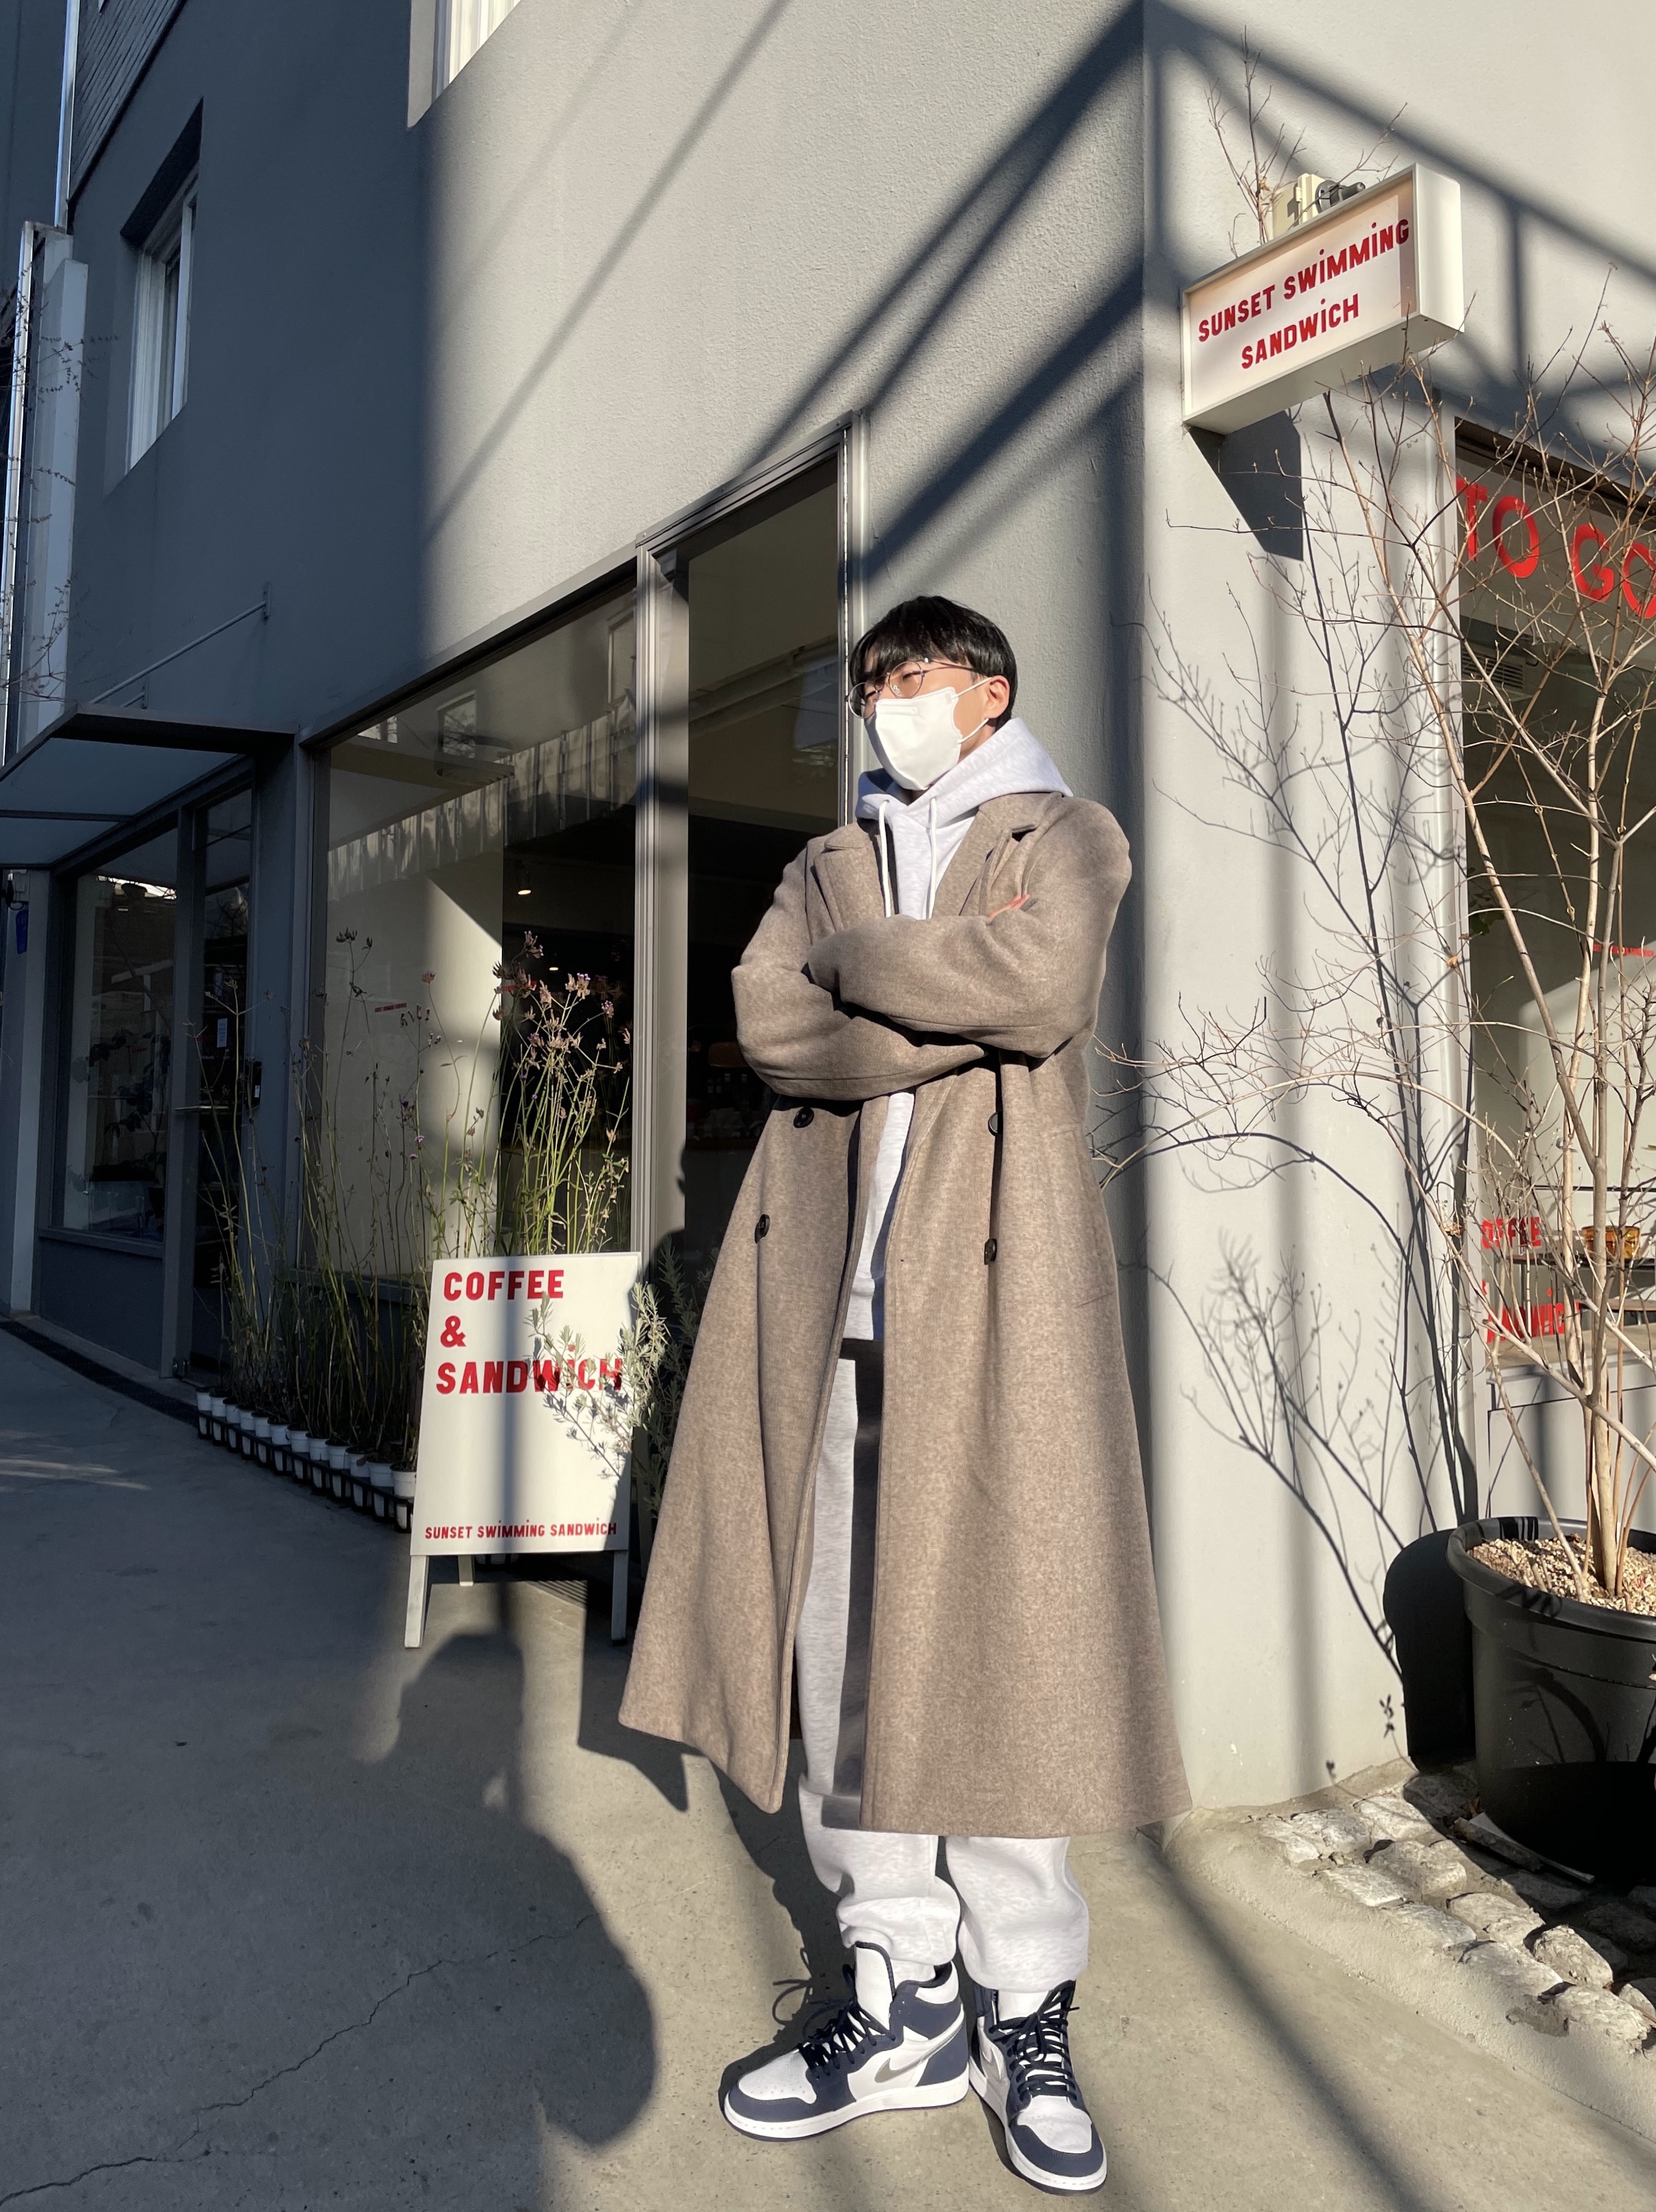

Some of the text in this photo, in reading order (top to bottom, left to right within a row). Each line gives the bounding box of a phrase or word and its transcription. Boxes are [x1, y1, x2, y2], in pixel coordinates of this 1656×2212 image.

[1198, 283, 1276, 342] SUNSET
[1455, 476, 1542, 579] TO
[443, 1269, 565, 1302] COFFEE
[439, 1315, 467, 1348] &
[425, 1525, 473, 1539] SUNSET
